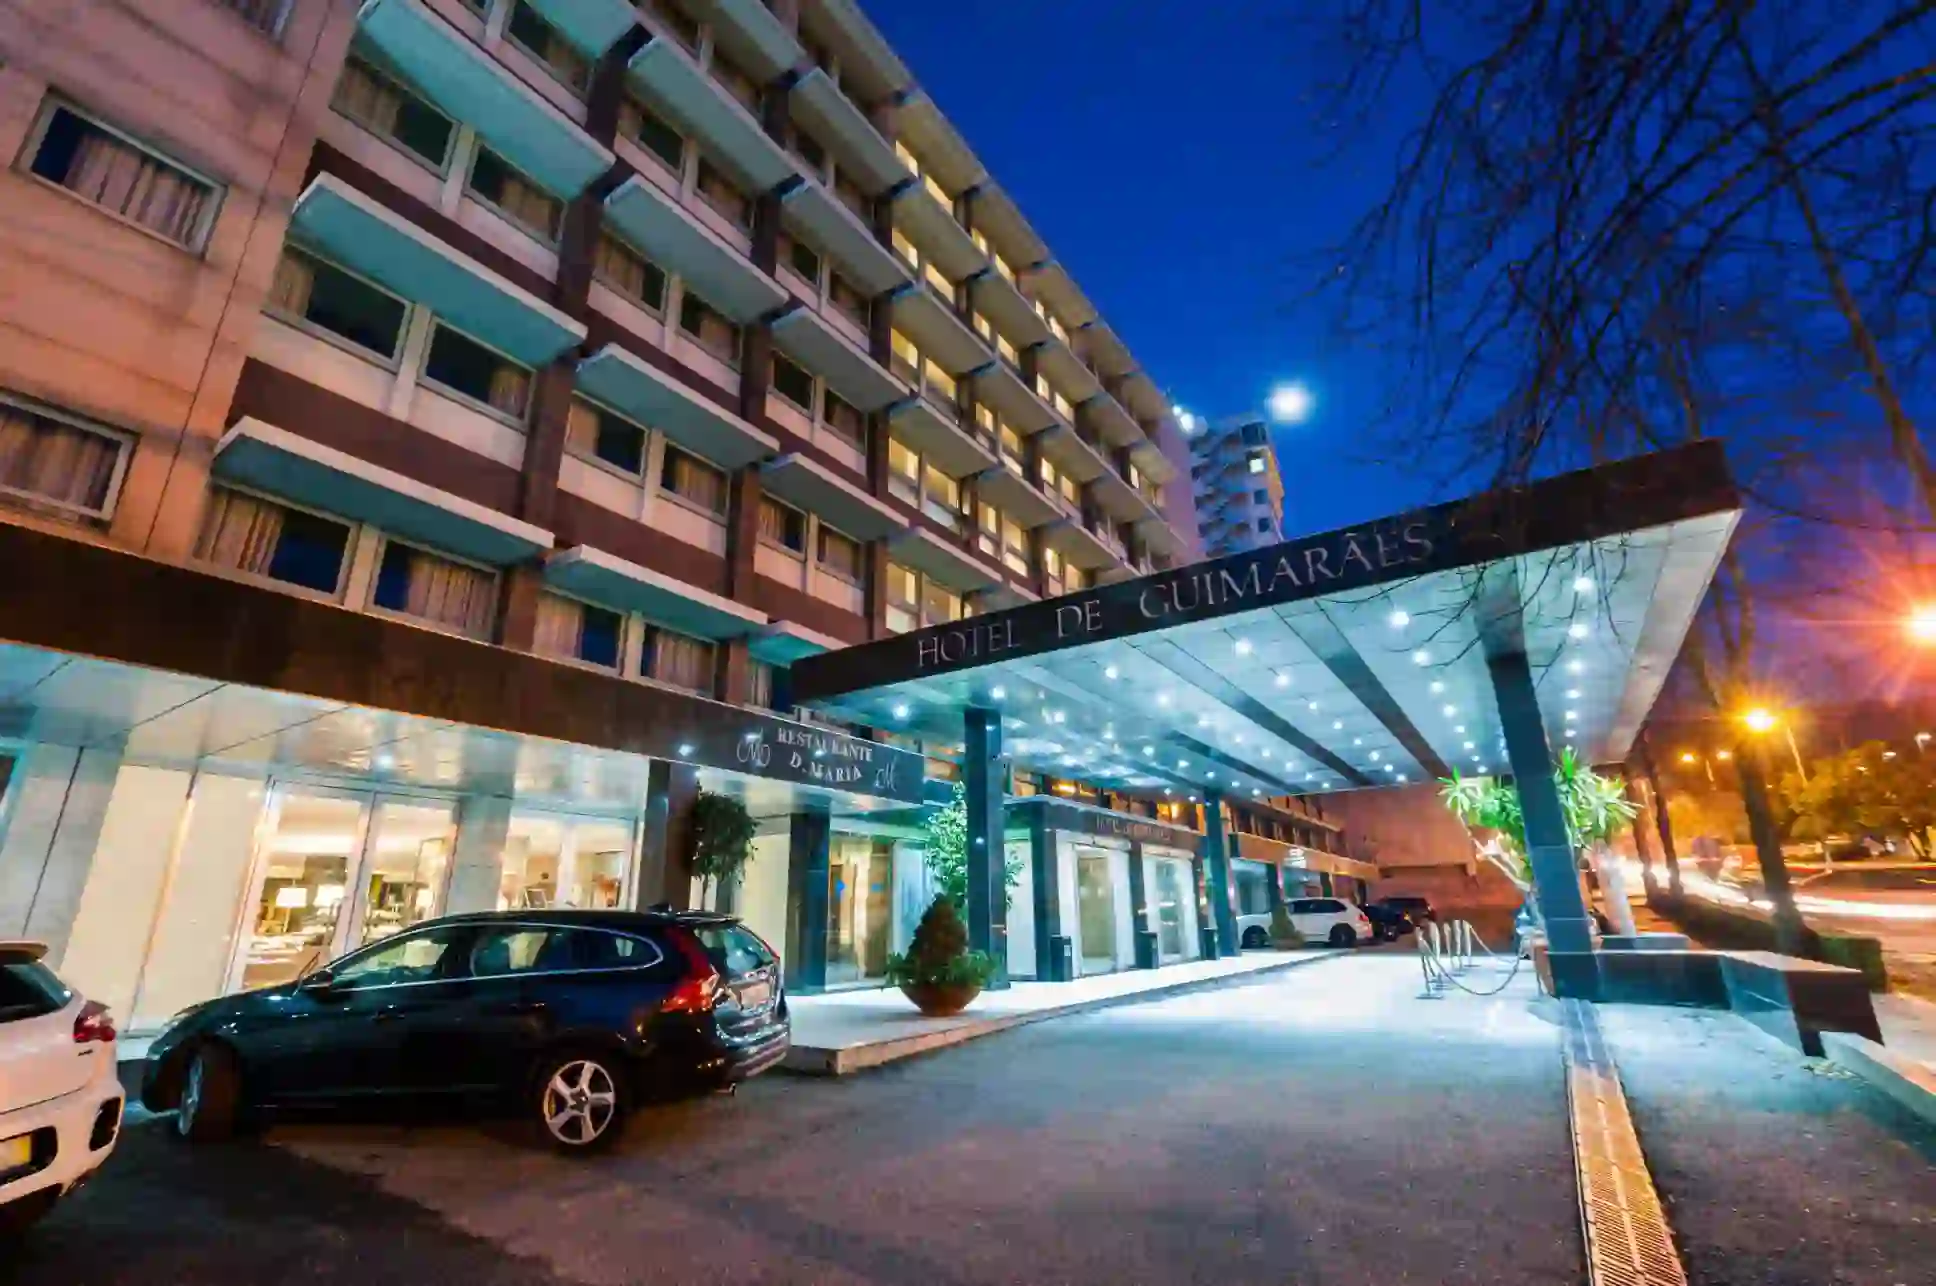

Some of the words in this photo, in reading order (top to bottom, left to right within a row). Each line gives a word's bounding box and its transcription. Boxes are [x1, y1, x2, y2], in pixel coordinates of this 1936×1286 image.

[917, 618, 1022, 668] HOTEL
[1055, 599, 1104, 639] DE
[1138, 522, 1435, 620] GUIMARÃES
[776, 727, 873, 763] RESTAURANTE
